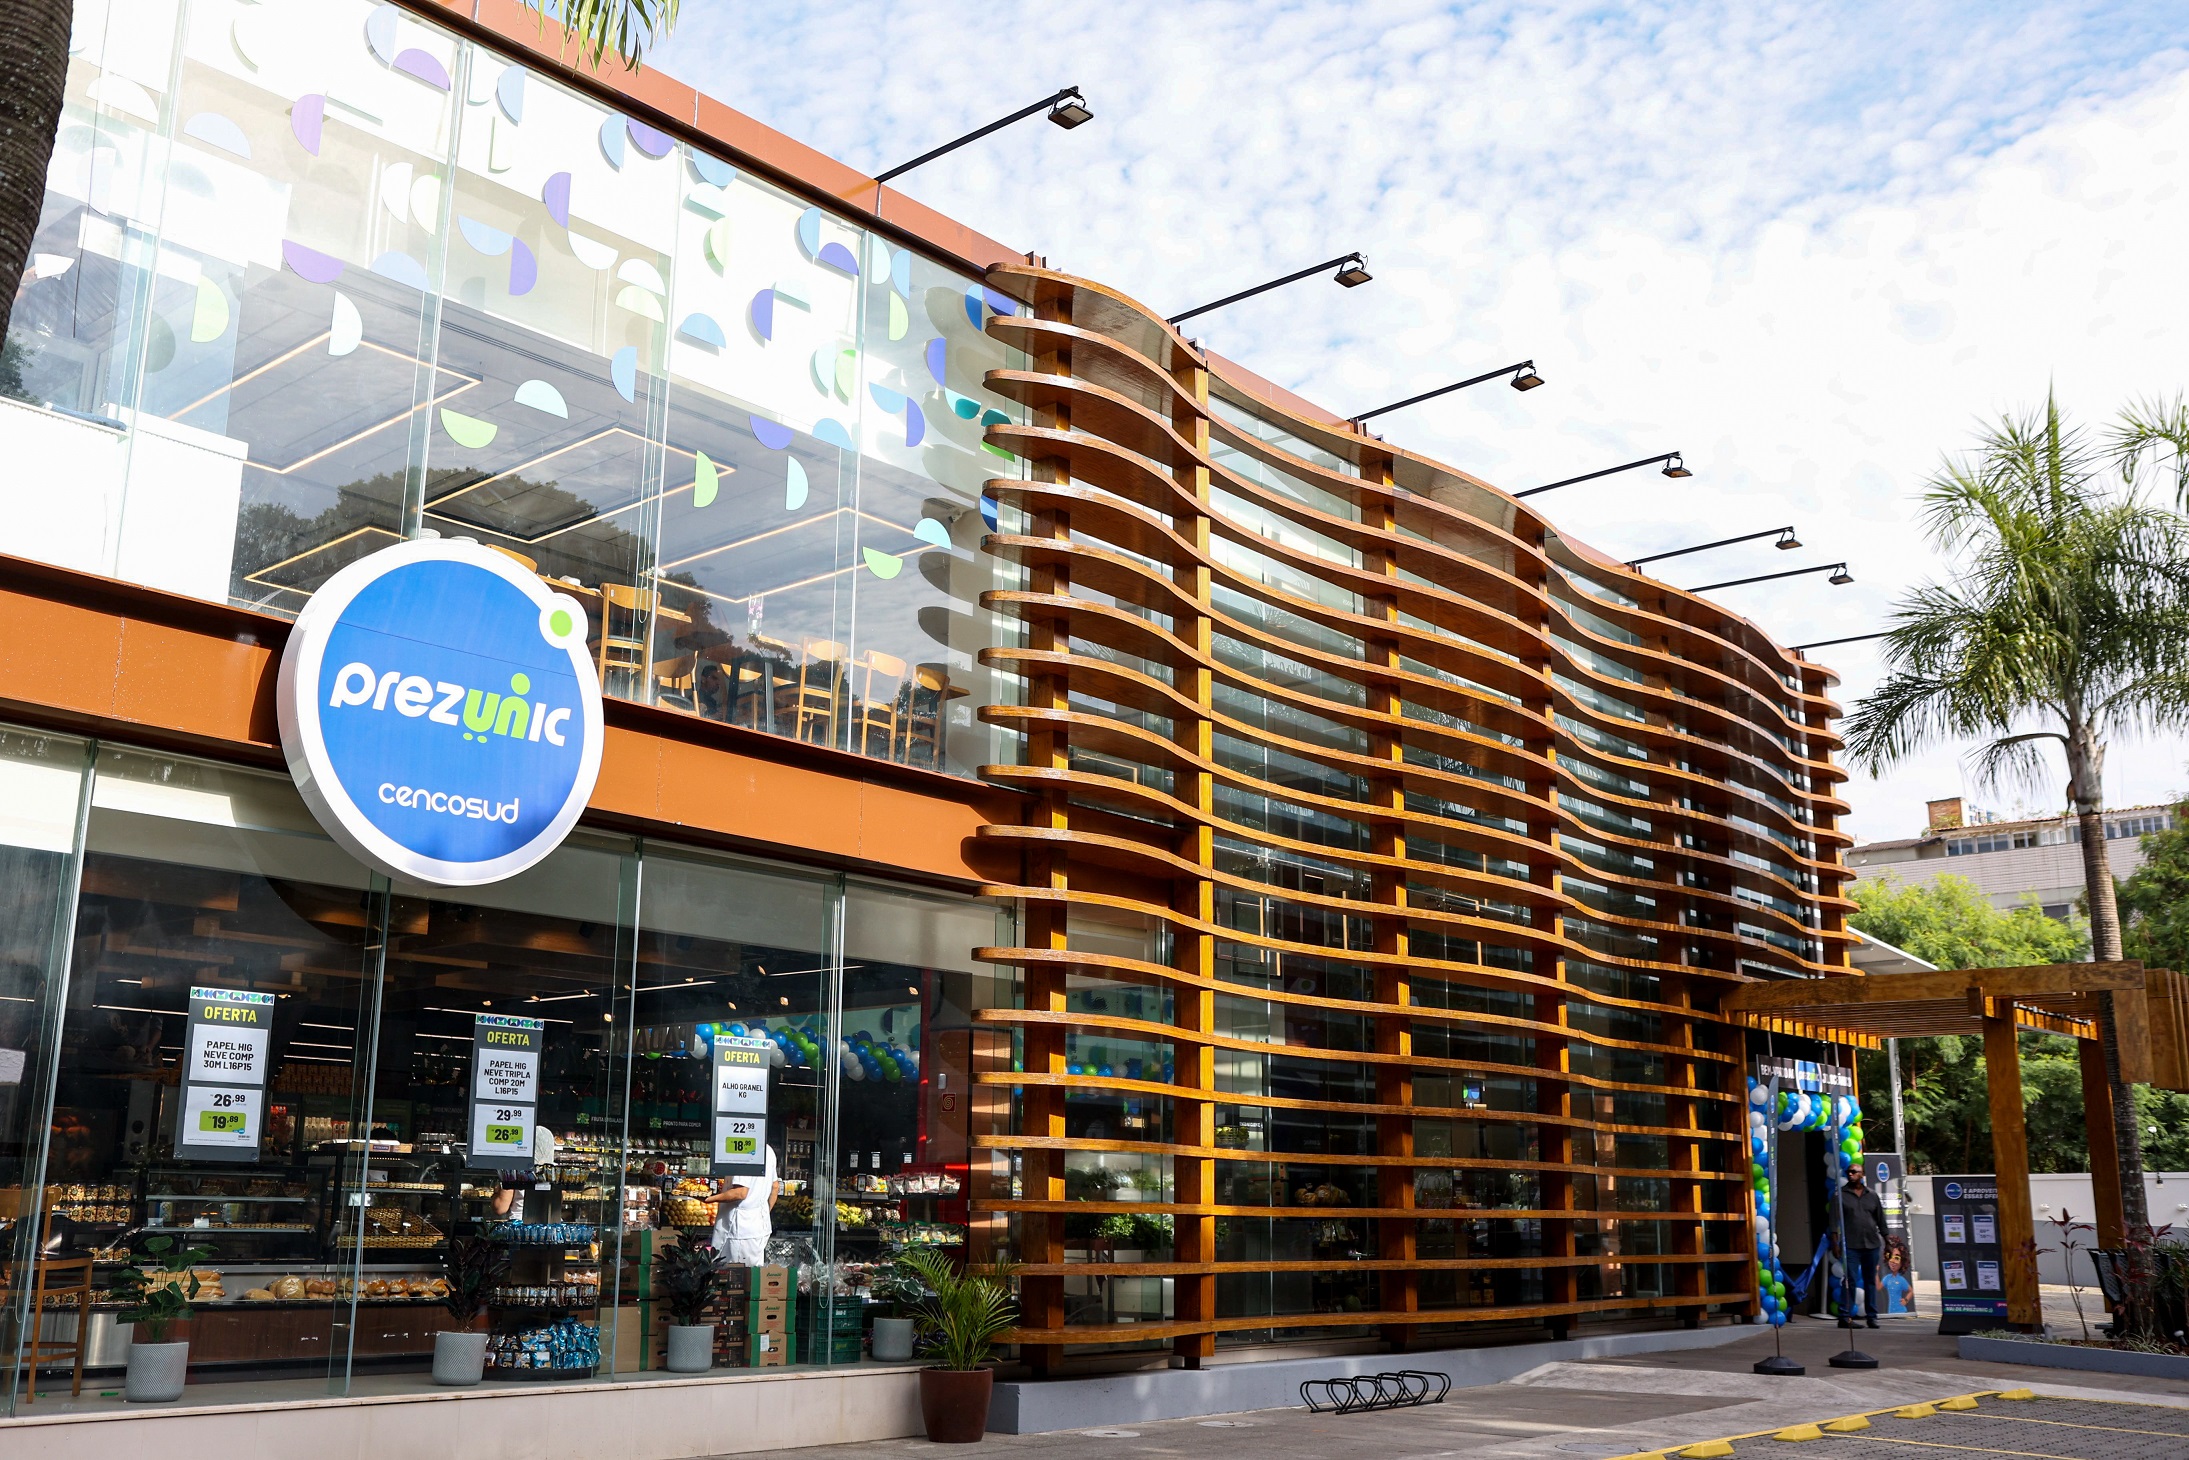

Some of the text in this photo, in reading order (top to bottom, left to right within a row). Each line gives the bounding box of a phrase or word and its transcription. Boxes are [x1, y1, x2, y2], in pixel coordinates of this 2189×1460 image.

[329, 662, 571, 747] prezunic
[378, 782, 519, 824] cencosud
[204, 1006, 257, 1022] OFERTA
[487, 1031, 530, 1046] OFERTA
[206, 1041, 253, 1051] PAPEL HIG
[203, 1051, 254, 1061] NEVE COMP
[724, 1050, 760, 1064] OFERTA
[203, 1060, 252, 1071] 30M L16P15
[490, 1060, 527, 1070] PAPEL HIG
[484, 1069, 531, 1079] NEVE TRIPLA
[488, 1077, 525, 1087] COMP 20M
[722, 1082, 763, 1092] ALHO GRANEL
[213, 1094, 246, 1107] 26,99
[738, 1091, 747, 1099] KG
[496, 1109, 522, 1121] 29,99
